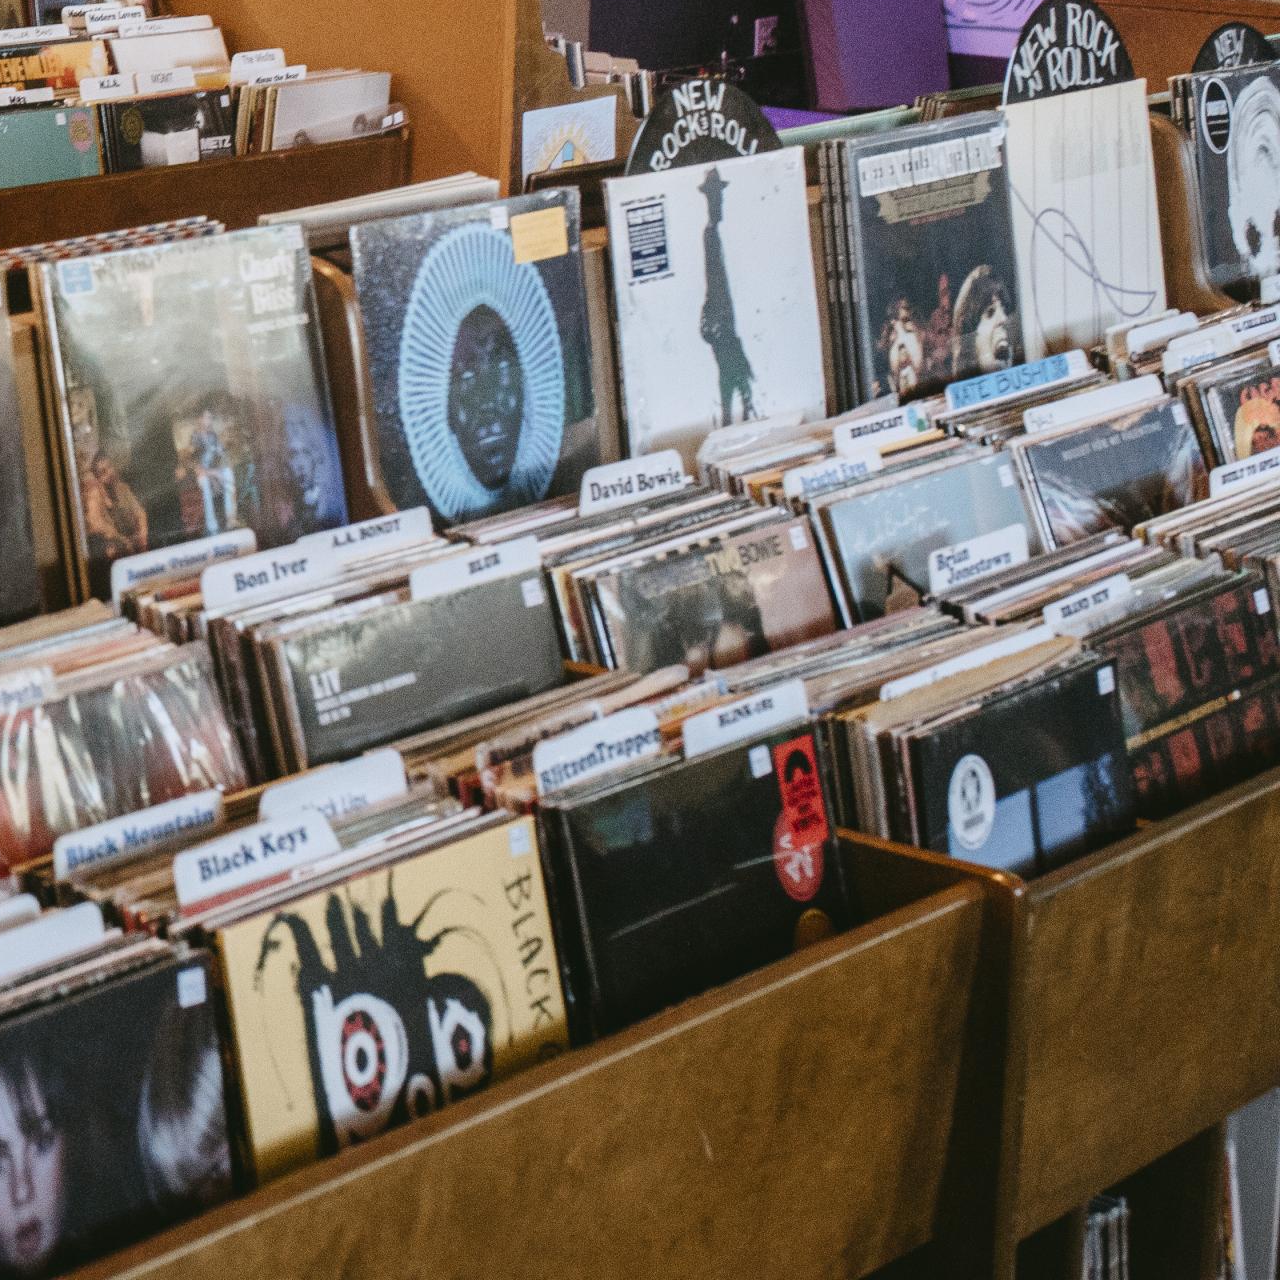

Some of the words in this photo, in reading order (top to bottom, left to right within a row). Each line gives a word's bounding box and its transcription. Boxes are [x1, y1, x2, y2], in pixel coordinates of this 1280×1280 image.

[1013, 8, 1058, 95] NEW
[1065, 2, 1121, 75] ROCK
[1046, 46, 1105, 92] ROLL
[671, 79, 727, 119] NEW
[650, 118, 699, 172] ROCK
[711, 114, 760, 157] ROLL
[589, 469, 634, 503] David
[638, 460, 684, 493] Bowie
[739, 535, 784, 567] BOWIE
[935, 548, 970, 572] Brian
[233, 566, 270, 593] Bon
[274, 556, 310, 586] Iver
[66, 834, 119, 866] Black
[197, 840, 256, 882] Black
[259, 823, 310, 861] Keys
[504, 873, 555, 1026] BLACK
